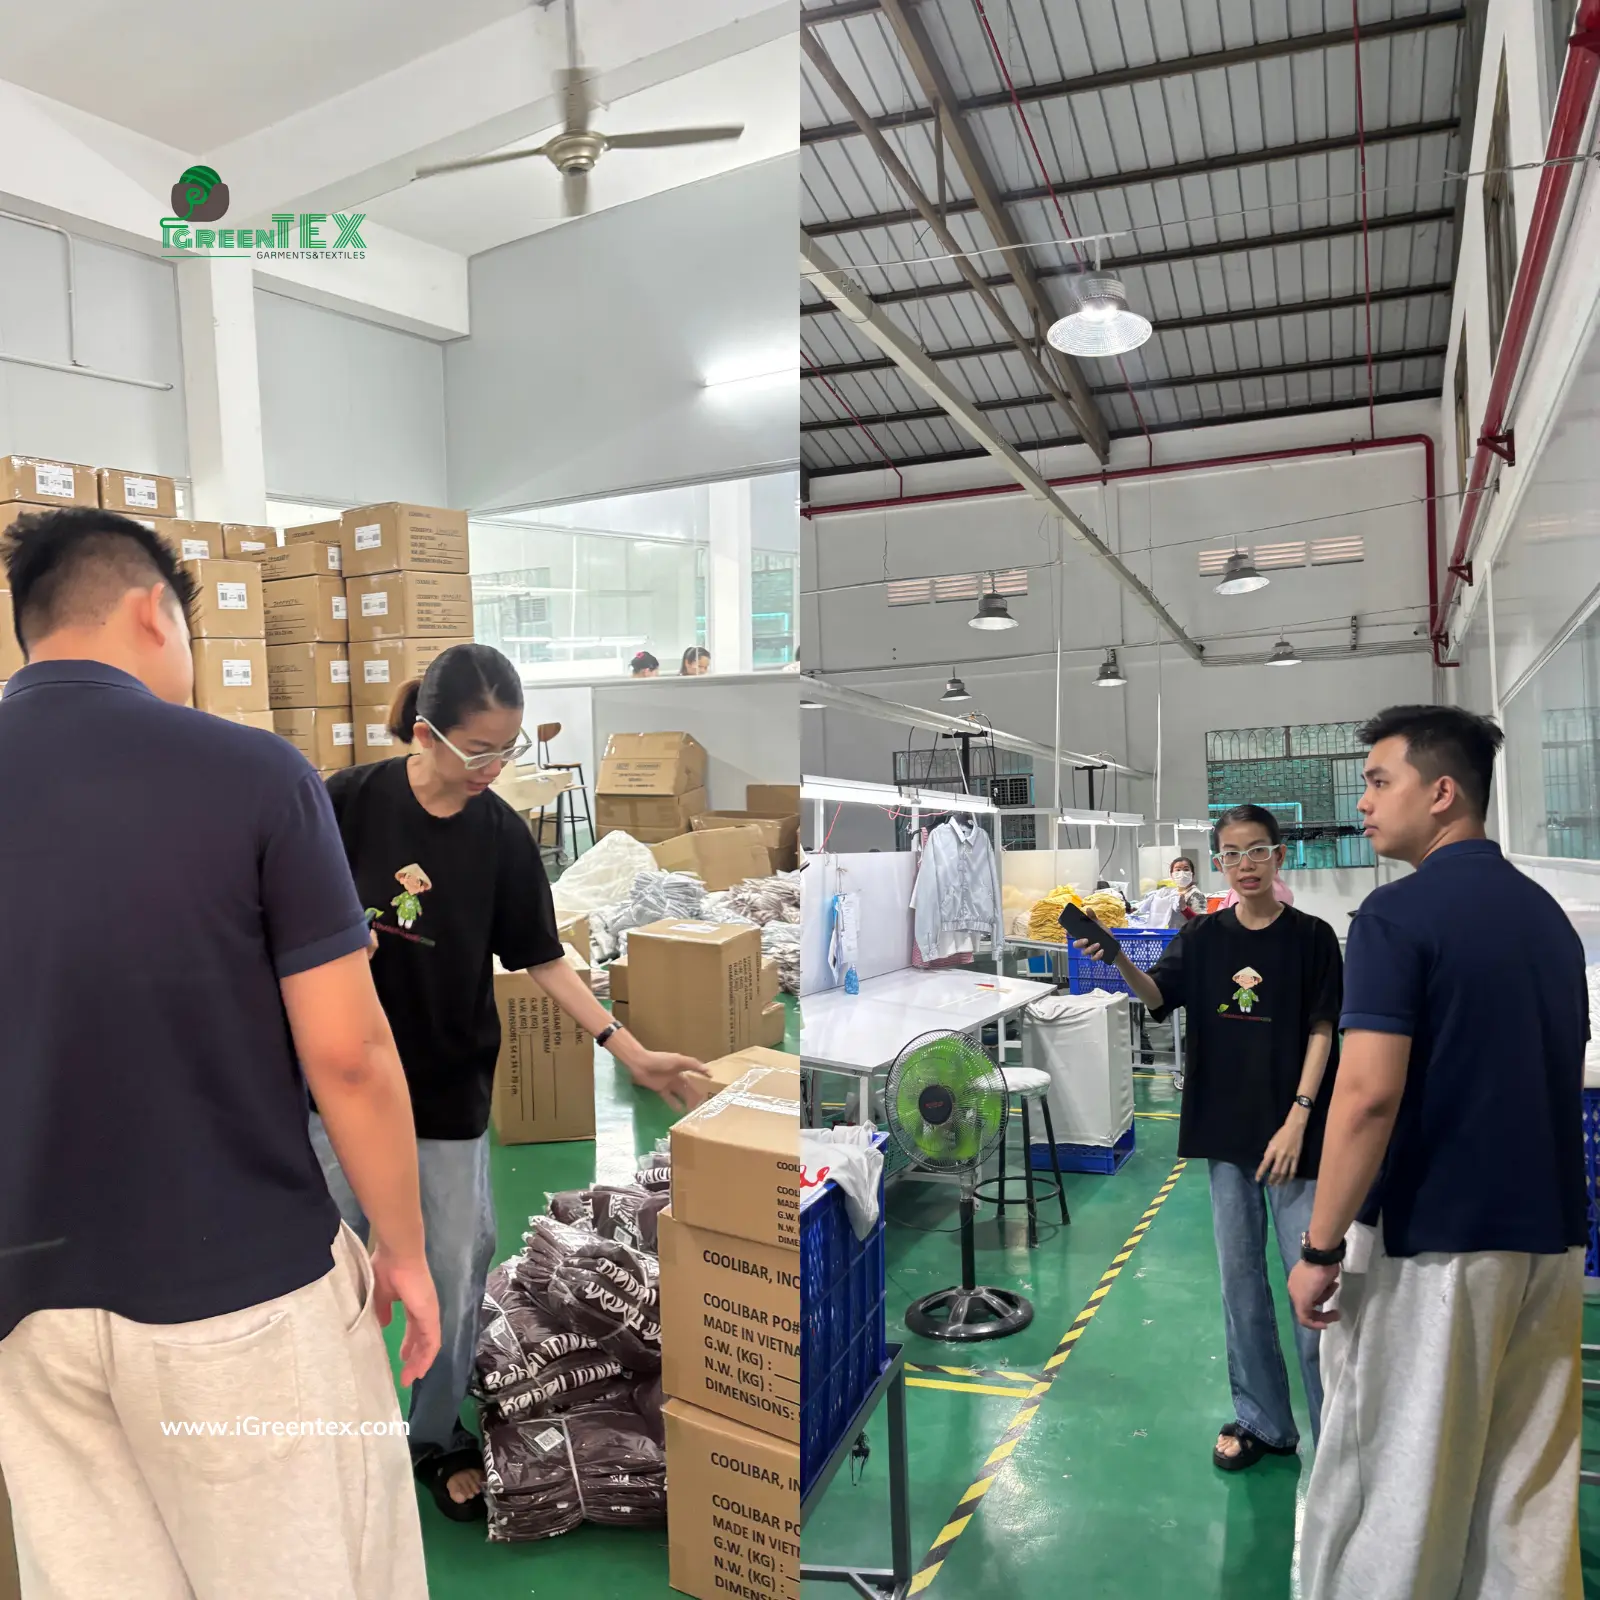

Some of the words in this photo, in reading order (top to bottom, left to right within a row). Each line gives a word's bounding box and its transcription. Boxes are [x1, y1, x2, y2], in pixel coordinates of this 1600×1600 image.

[777, 1198, 800, 1210] MADE
[777, 1211, 796, 1222] G.W.
[778, 1223, 796, 1235] N.W.
[703, 1249, 773, 1284] COOLIBAR,
[776, 1270, 800, 1290] INC
[703, 1292, 768, 1326] COOLIBAR
[772, 1315, 800, 1335] PO#
[703, 1314, 738, 1338] MADE
[742, 1327, 754, 1343] IN
[704, 1335, 733, 1357] G.W.
[737, 1346, 764, 1371] (KG)
[704, 1356, 733, 1378] N.W.
[737, 1367, 765, 1392] (KG)
[705, 1376, 794, 1421] DIMENSIONS:
[711, 1452, 784, 1490] COOLIBAR,
[712, 1494, 780, 1530] COOLIBAR
[712, 1514, 749, 1540] MADE
[752, 1529, 765, 1546] IN
[713, 1535, 744, 1558] G.W.
[747, 1547, 775, 1573] (KG)
[714, 1555, 744, 1578] N.W.
[747, 1568, 776, 1593] (KG)
